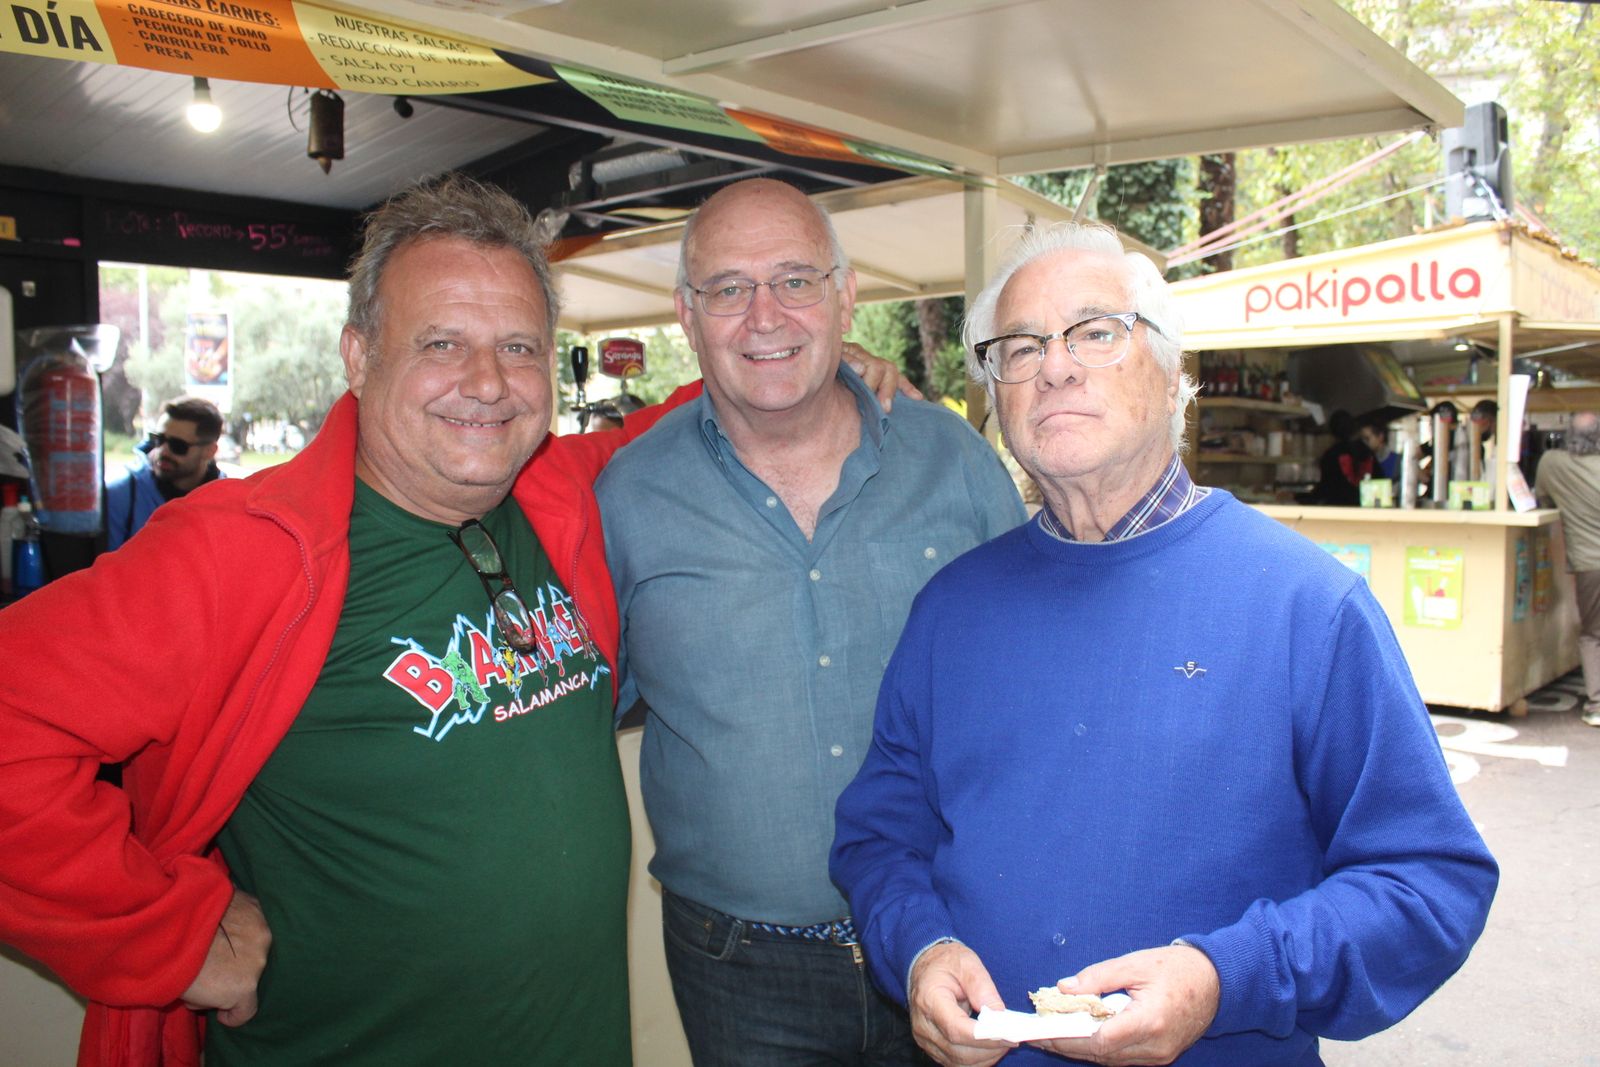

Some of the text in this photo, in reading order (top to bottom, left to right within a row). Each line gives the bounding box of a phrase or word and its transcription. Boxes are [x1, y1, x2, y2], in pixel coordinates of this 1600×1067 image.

[11, 1, 103, 52] DÍA
[128, 3, 267, 41] CABECERO DE LOMO
[207, 0, 281, 26] CARNES:
[132, 17, 272, 52] PECHUGA DE POLLO
[138, 30, 230, 56] CARRILLERA
[317, 32, 412, 60] REDUCCIÓN
[421, 51, 443, 64] DE
[334, 15, 469, 54] NUESTRAS SALSAS:
[144, 42, 194, 61] PRESA
[331, 55, 387, 71] SALSA
[346, 73, 480, 88] MOJO CANARIO
[1246, 260, 1482, 323] pakipalla
[494, 671, 590, 722] SALAMANCA
